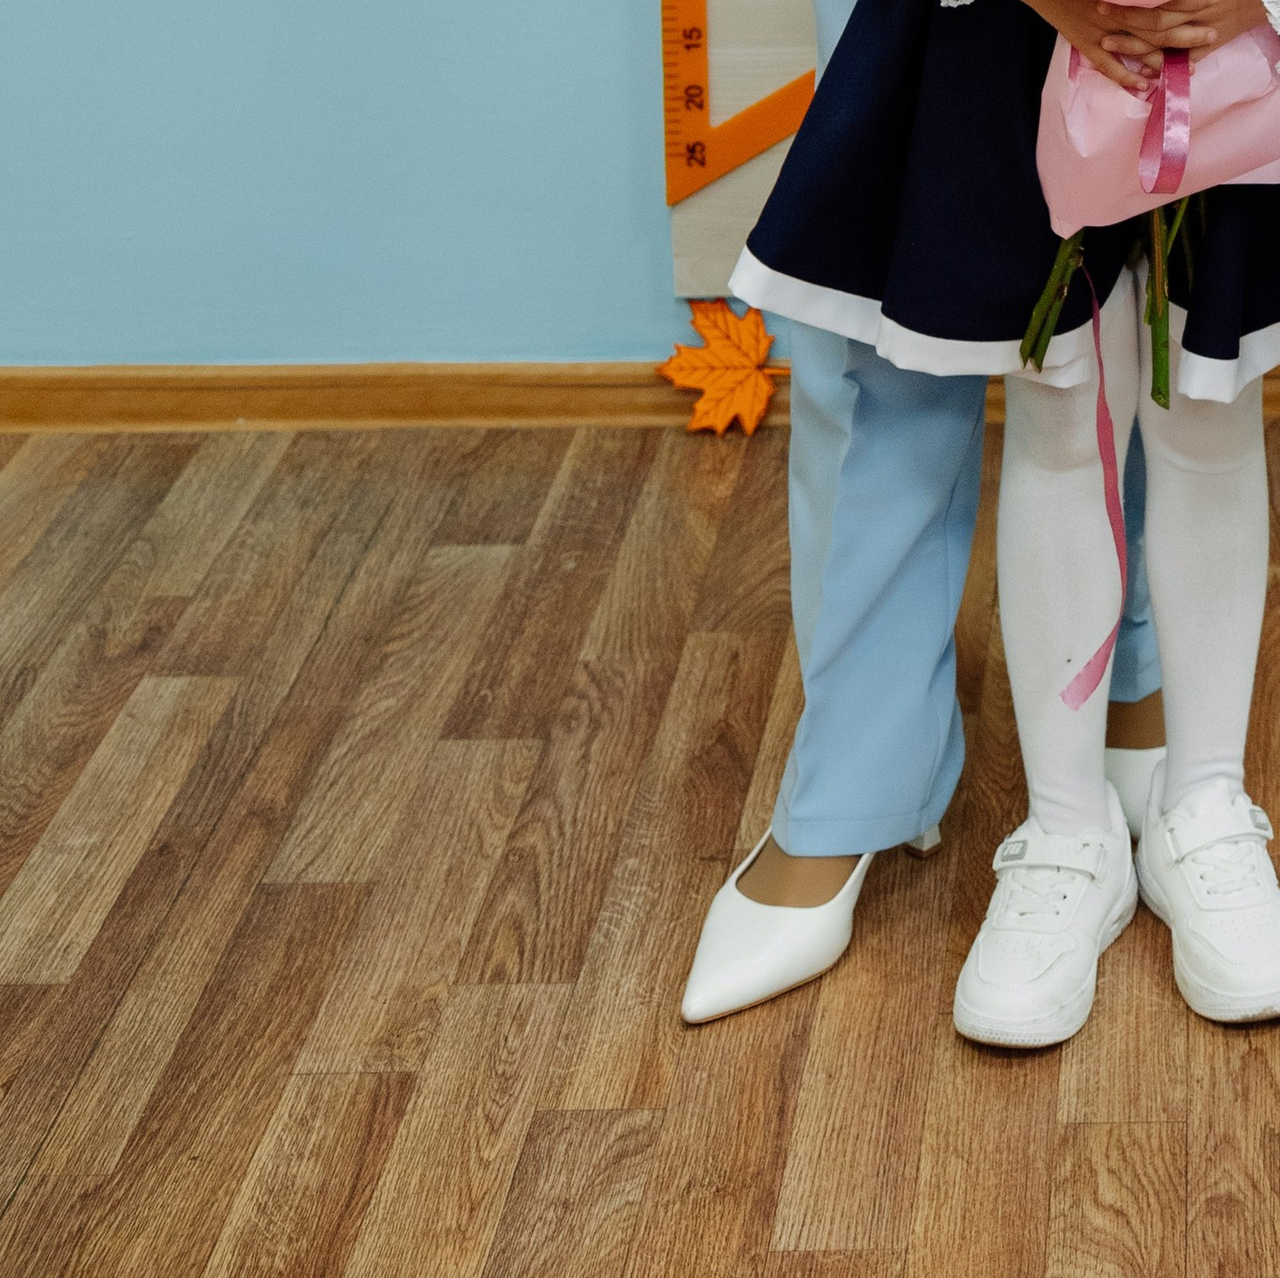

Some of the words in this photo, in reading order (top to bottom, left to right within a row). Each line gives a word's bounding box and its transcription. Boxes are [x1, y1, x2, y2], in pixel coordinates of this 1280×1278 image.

[682, 26, 703, 51] 15
[683, 84, 705, 111] 20
[686, 141, 707, 168] 25
